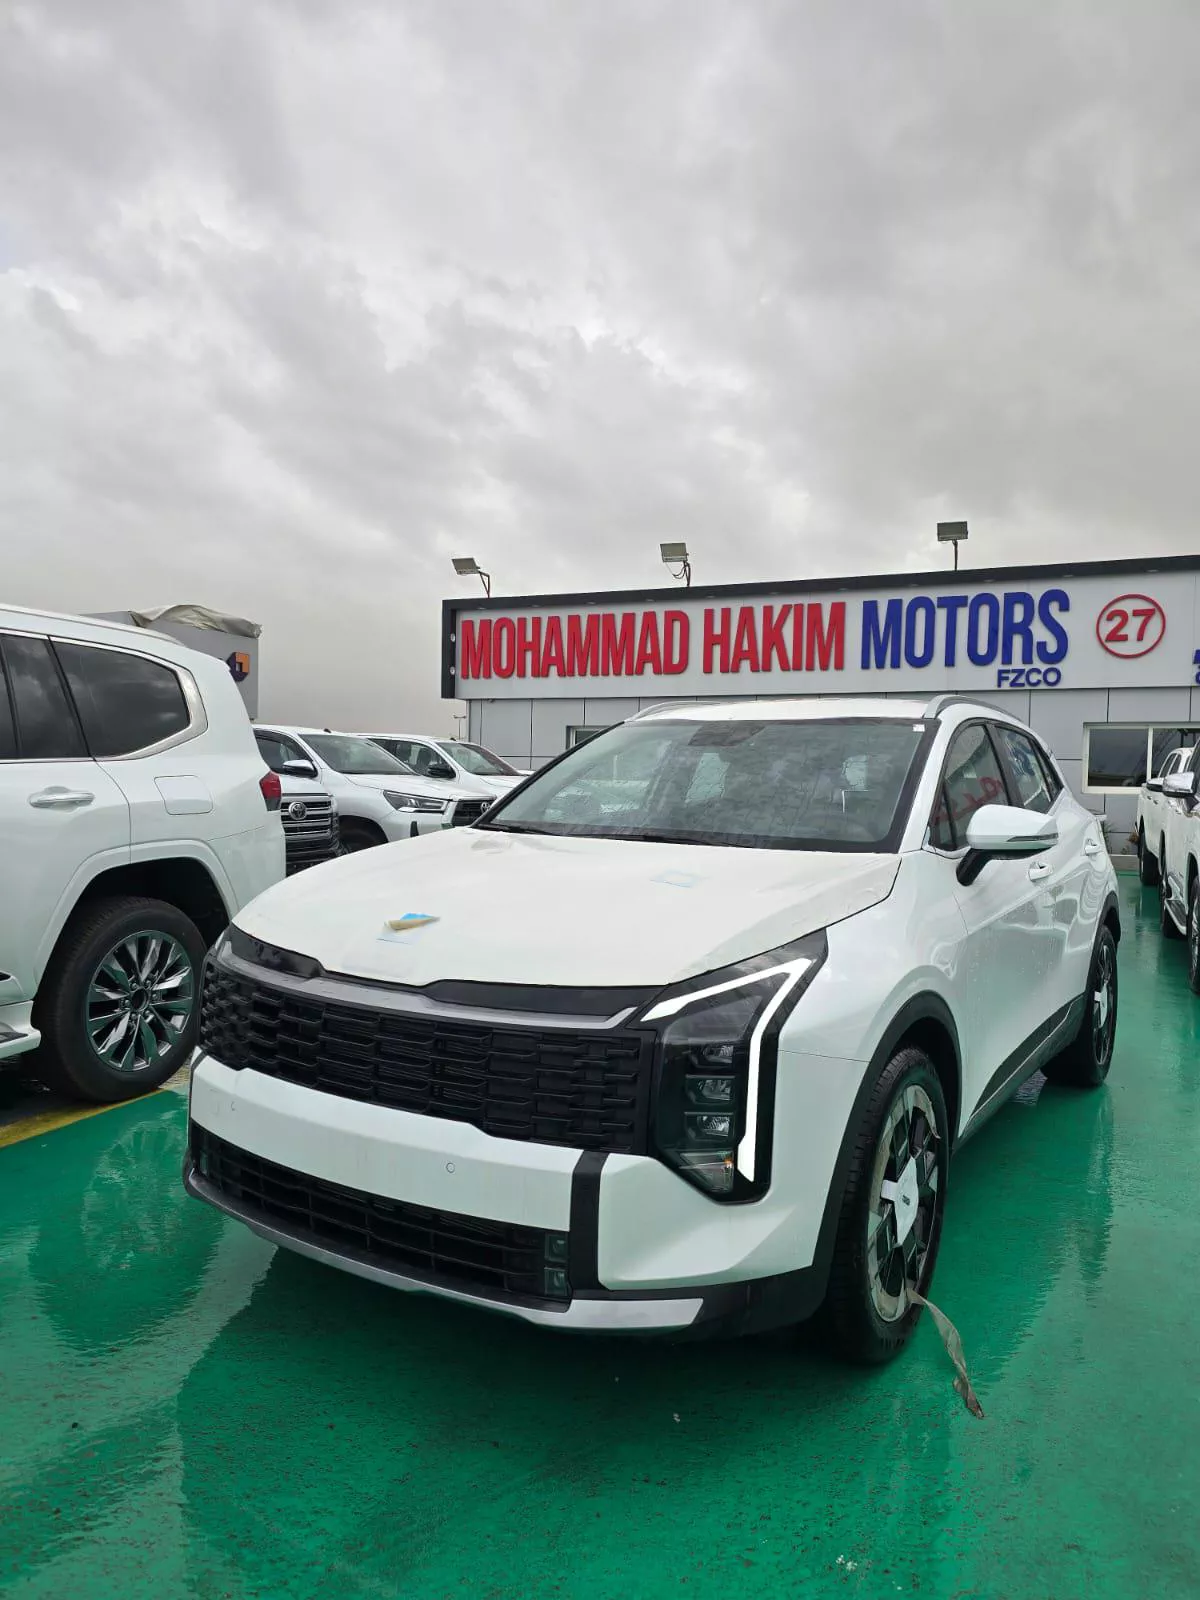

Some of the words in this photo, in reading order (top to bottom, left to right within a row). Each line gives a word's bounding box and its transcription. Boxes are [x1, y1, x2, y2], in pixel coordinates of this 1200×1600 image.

[461, 610, 690, 680] MOHAMMAD
[703, 602, 846, 674] HAKIM
[860, 588, 1070, 670] MOTORS
[1105, 608, 1156, 643] 27
[997, 666, 1062, 689] FZCO
